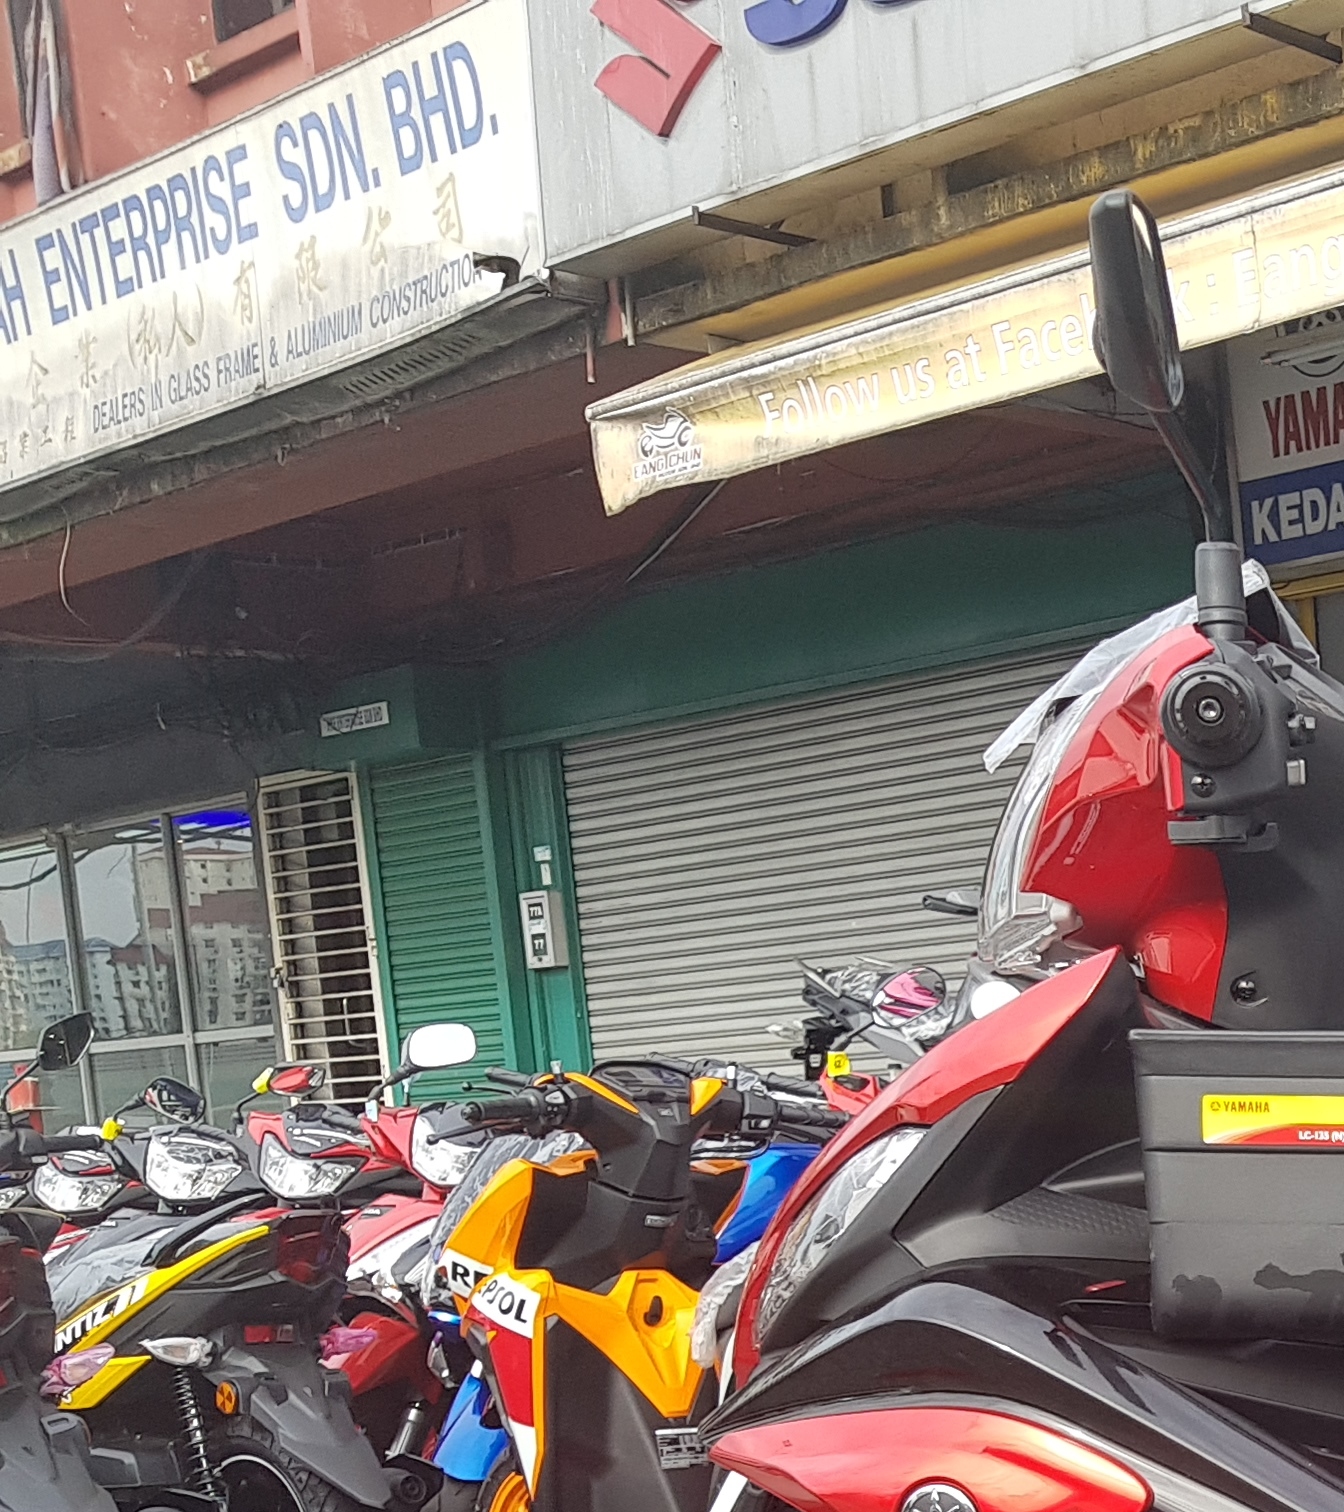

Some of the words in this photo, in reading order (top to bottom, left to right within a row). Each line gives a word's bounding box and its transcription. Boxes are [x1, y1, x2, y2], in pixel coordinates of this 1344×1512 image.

[35, 144, 259, 326] ENTERPRISE
[275, 93, 380, 223] SDN.
[382, 40, 499, 177] BHD.
[93, 387, 146, 434] DEALERS
[151, 381, 164, 411] IN
[168, 361, 211, 404] GLASS
[216, 342, 260, 388] FRAME
[269, 336, 280, 368] &
[286, 302, 363, 362] ALUMINIUM
[756, 364, 881, 438] Follow
[896, 353, 935, 406] us
[945, 337, 987, 393] at
[1223, 1101, 1271, 1113] YAMAHA
